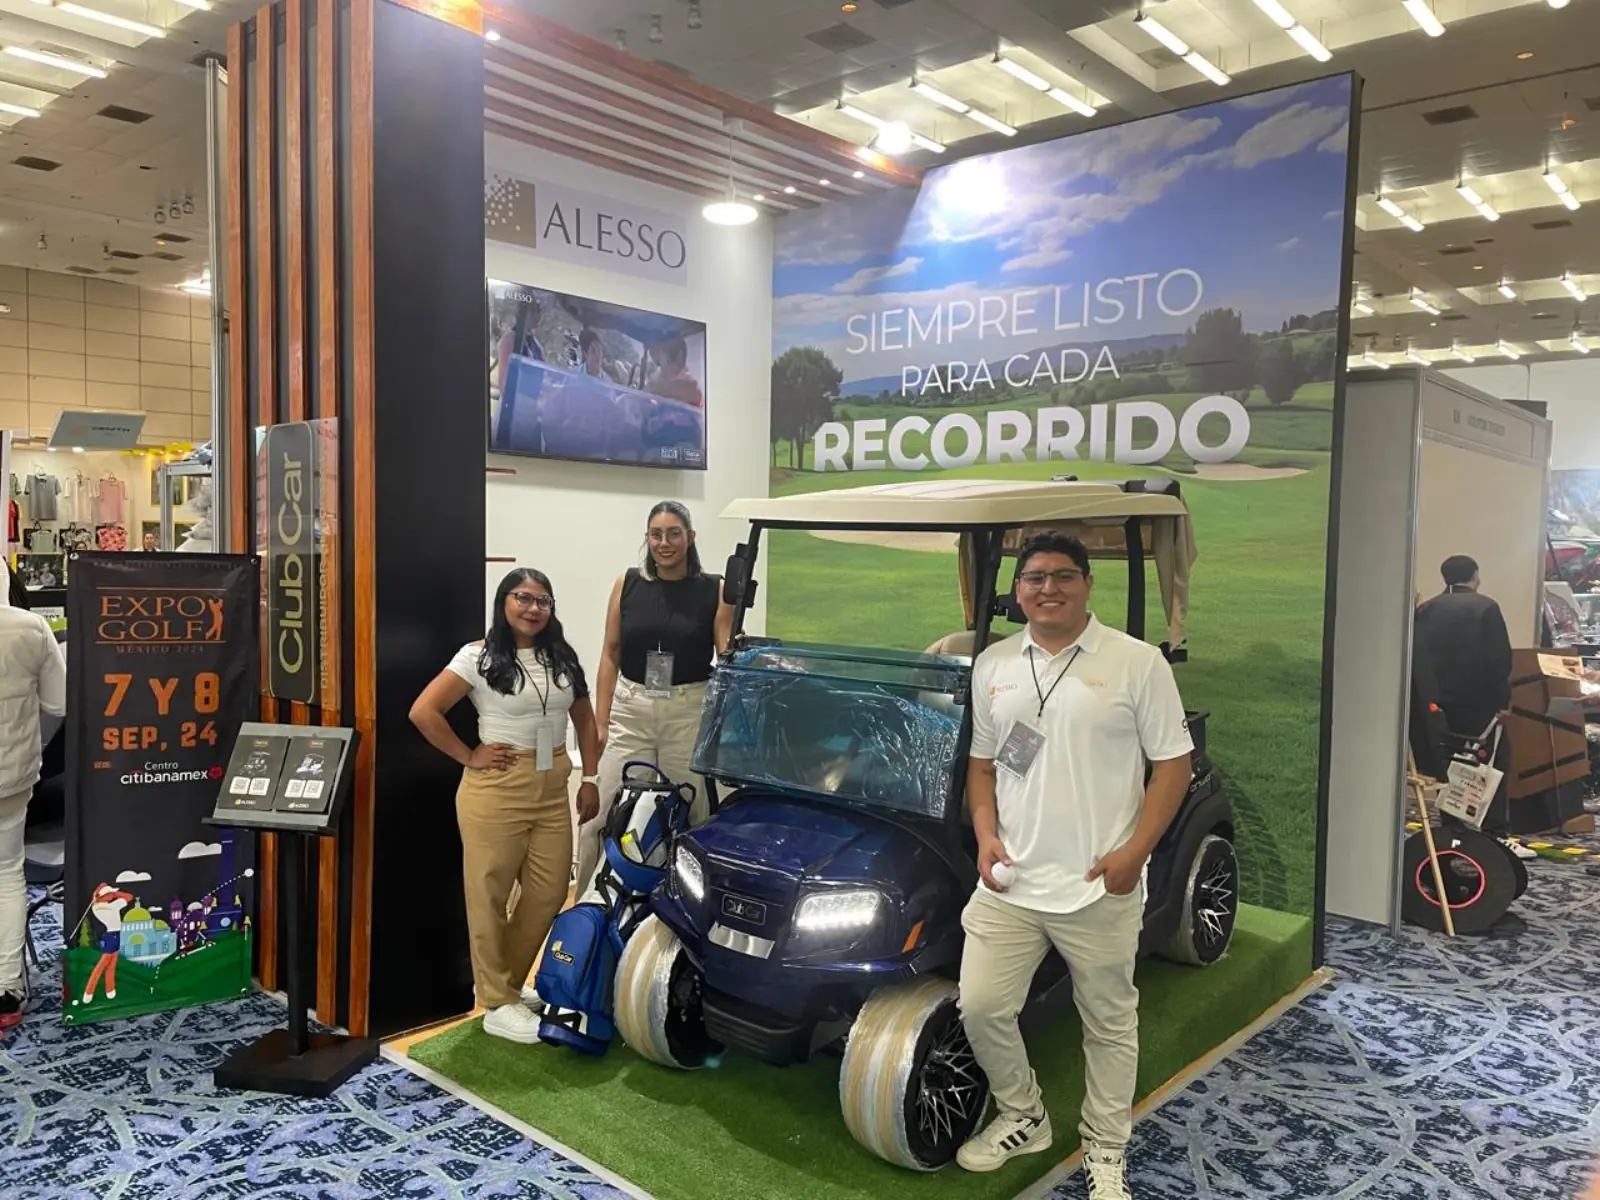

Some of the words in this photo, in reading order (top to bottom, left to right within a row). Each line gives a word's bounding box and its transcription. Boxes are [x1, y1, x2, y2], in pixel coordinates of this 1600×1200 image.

[543, 202, 687, 269] ALESSO
[845, 290, 1039, 355] SIEMPRE
[1054, 268, 1204, 331] LISTO
[901, 357, 995, 397] PARA
[1004, 345, 1120, 388] CADA
[813, 395, 1251, 472] RECORRIDO
[278, 452, 304, 545] Car
[98, 619, 205, 640] GOLF
[100, 595, 206, 617] EXPO
[278, 553, 304, 674] Club
[319, 558, 329, 690] DISTRIBUIDOR
[104, 674, 132, 716] 7
[148, 678, 179, 715] Y
[194, 672, 220, 714] 8
[181, 720, 218, 747] 24
[120, 769, 208, 785] citibanamex
[144, 761, 179, 770] Centro
